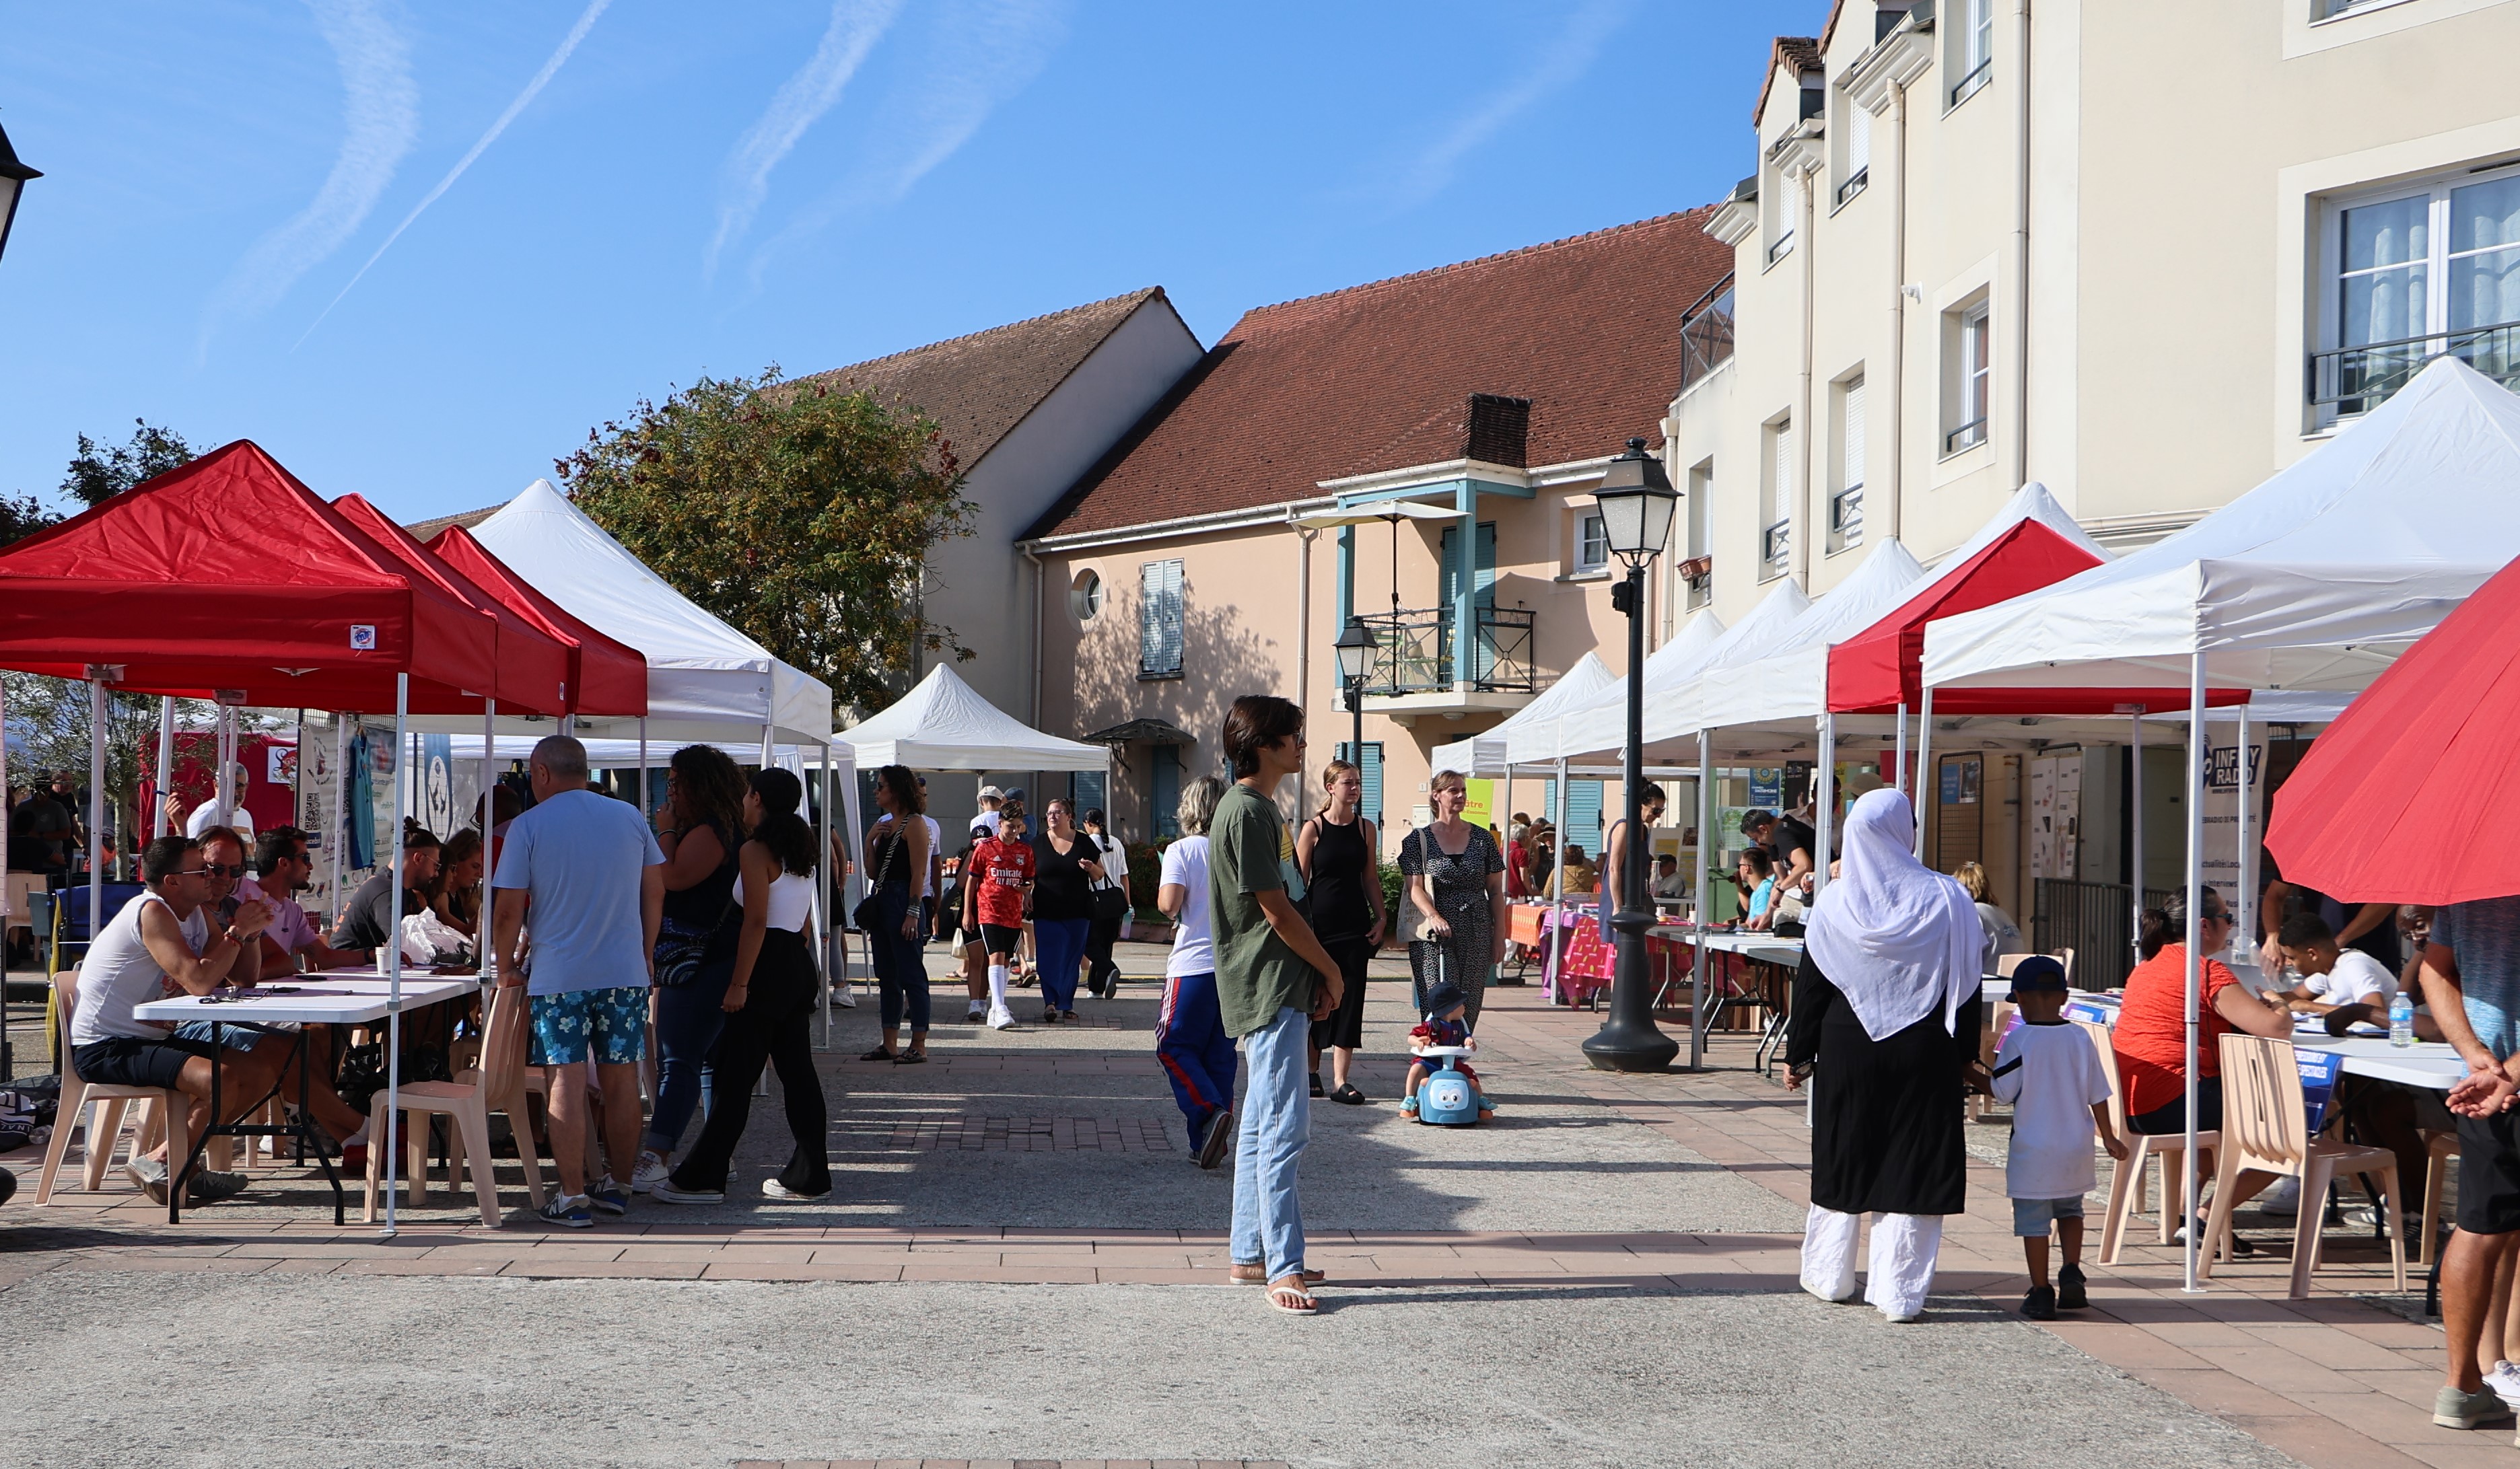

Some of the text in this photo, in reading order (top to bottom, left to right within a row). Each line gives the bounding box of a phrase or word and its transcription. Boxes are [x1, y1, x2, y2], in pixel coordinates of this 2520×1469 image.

[2216, 766, 2253, 784] RADO
[990, 867, 1022, 877] Emirate
[549, 1203, 557, 1216] N
